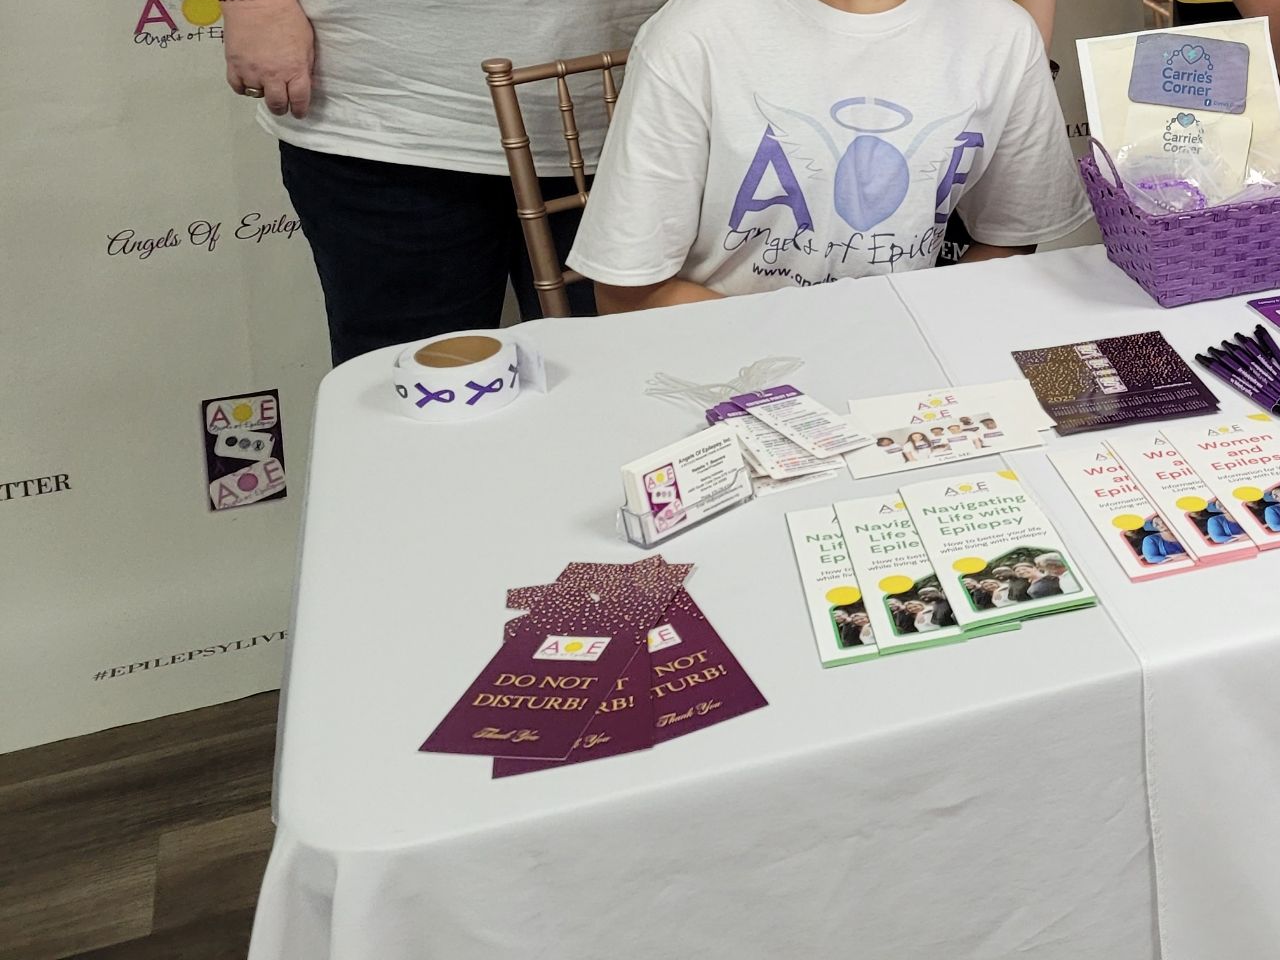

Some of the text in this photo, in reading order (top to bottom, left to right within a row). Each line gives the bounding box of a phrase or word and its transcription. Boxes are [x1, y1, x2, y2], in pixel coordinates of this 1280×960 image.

[134, 27, 204, 48] Angels of
[1162, 66, 1213, 84] Carrie's
[1162, 80, 1212, 97] Corner
[107, 227, 181, 260] Angels
[188, 218, 220, 253] Of
[723, 222, 863, 264] Angels of
[1197, 433, 1273, 451] Women
[1226, 445, 1264, 458] and
[922, 493, 1027, 516] Navigating
[938, 504, 1022, 525] Life with
[854, 519, 911, 534] Navig
[940, 516, 1024, 537] Epilepsy
[869, 530, 906, 543] Life
[870, 538, 920, 554] Epile
[654, 650, 710, 678] NOT
[494, 673, 600, 690] DO NOT
[472, 693, 589, 712] DISTURB!
[656, 700, 724, 728] Thank You
[511, 728, 541, 743] You
[584, 732, 614, 750] You
